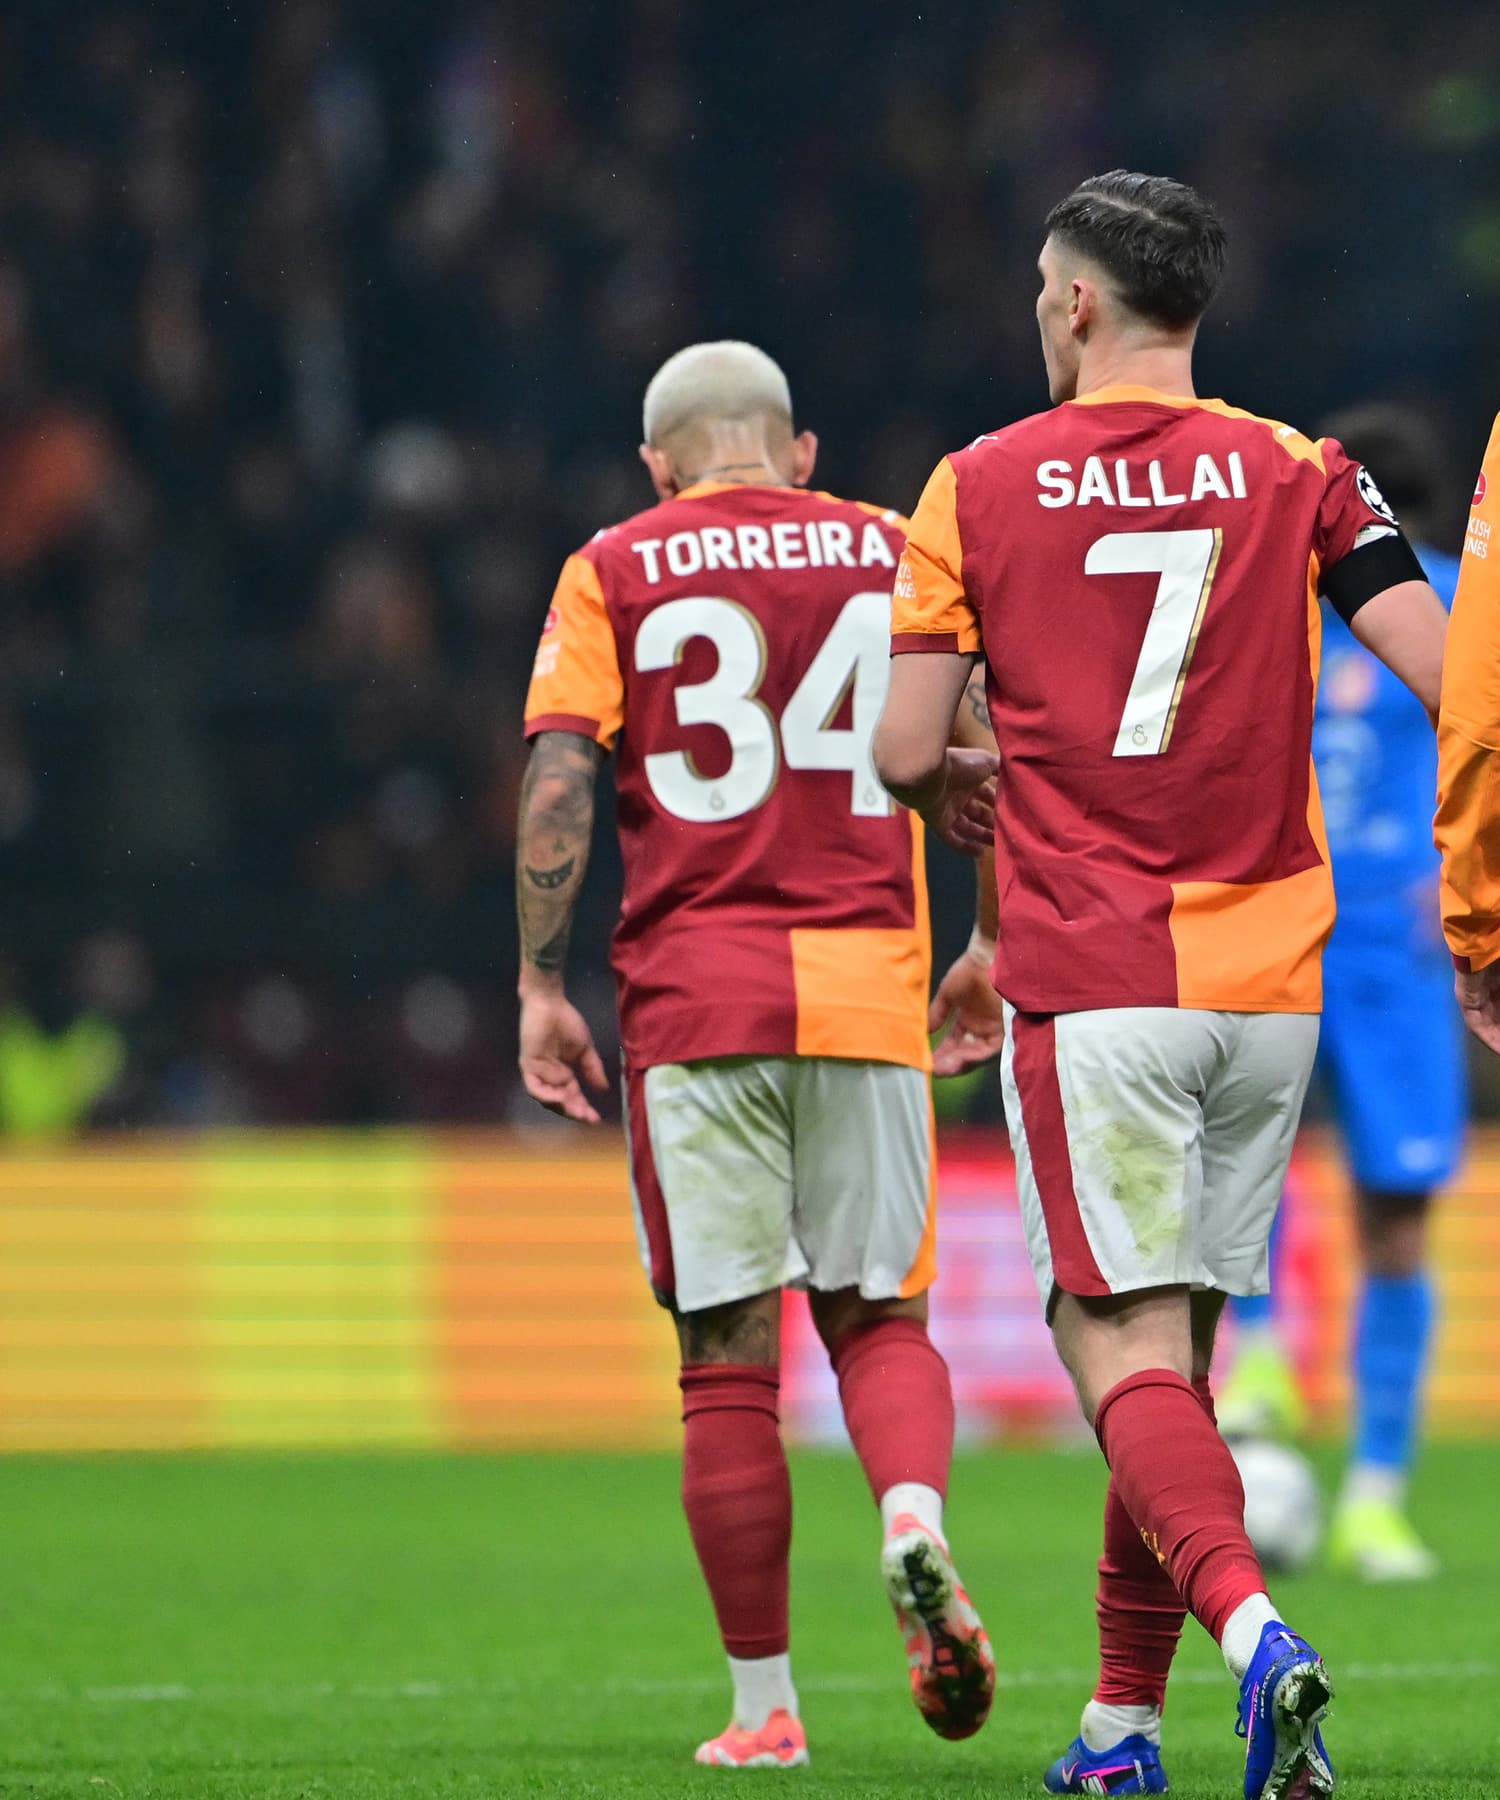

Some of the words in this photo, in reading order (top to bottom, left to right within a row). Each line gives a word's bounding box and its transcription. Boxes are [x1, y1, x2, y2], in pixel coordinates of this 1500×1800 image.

[1036, 452, 1247, 508] SALLAI
[632, 520, 894, 583] TORREIRA
[1467, 516, 1492, 540] KISH
[1085, 528, 1222, 757] 7
[635, 592, 895, 822] 34
